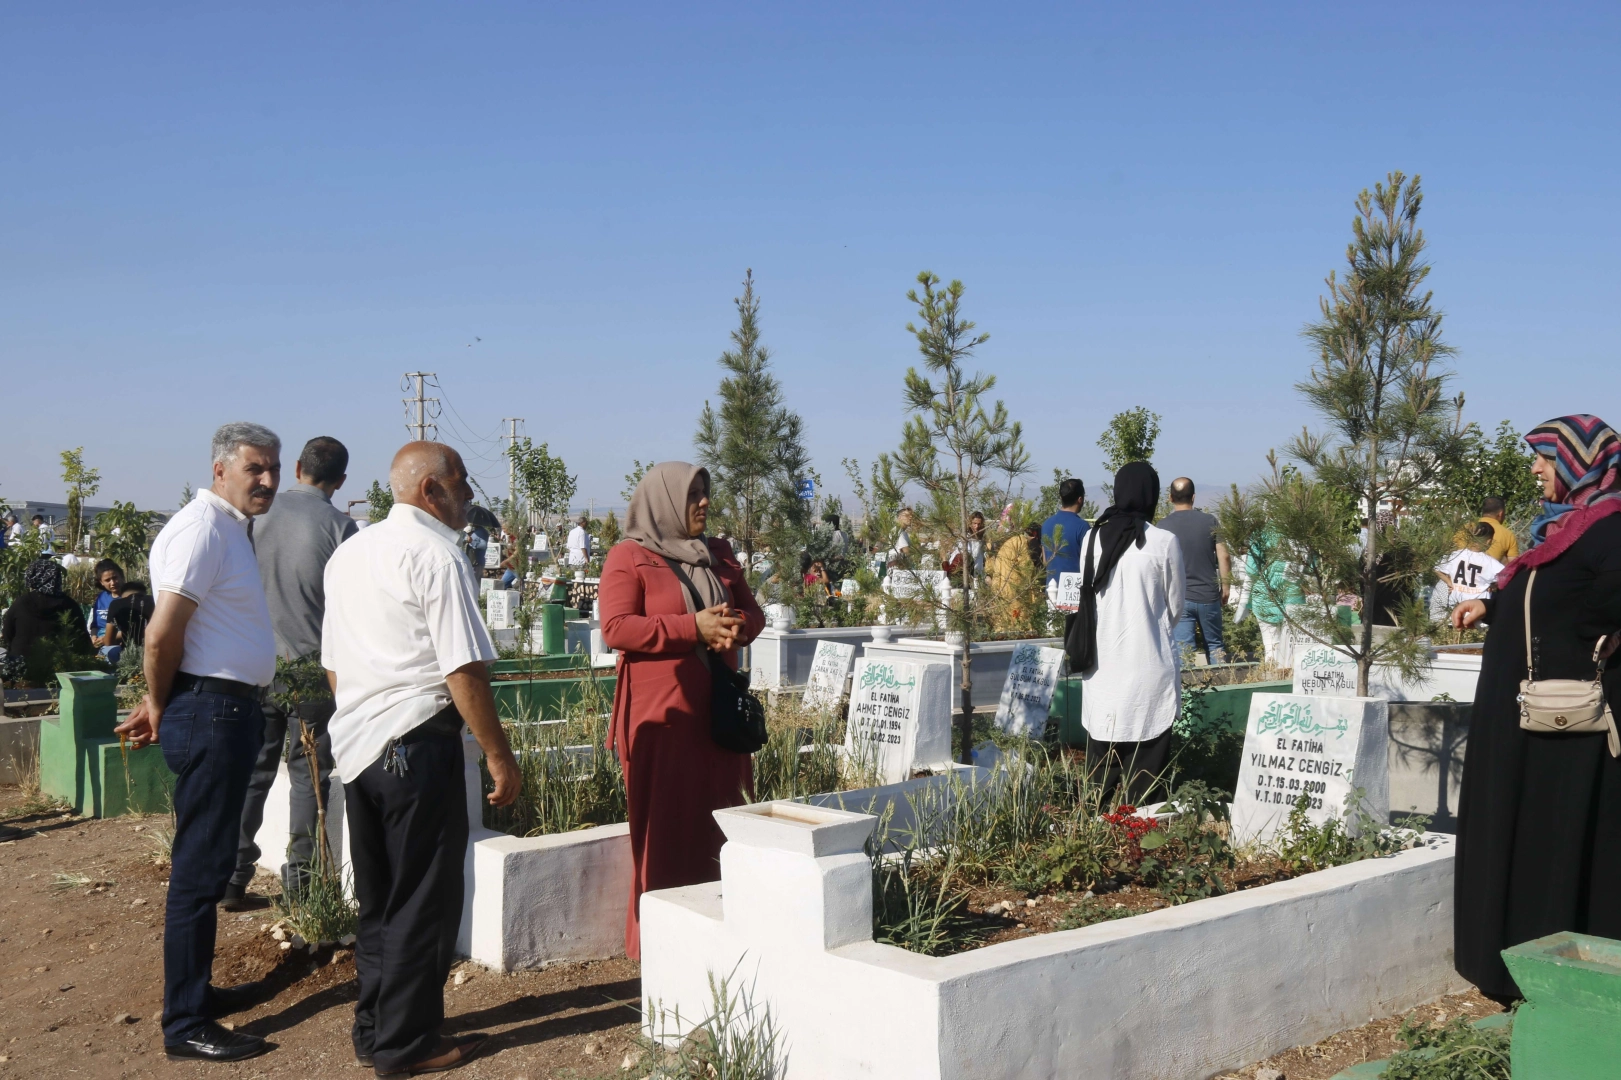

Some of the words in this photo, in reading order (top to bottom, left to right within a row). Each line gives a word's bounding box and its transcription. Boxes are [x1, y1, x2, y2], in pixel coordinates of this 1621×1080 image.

[1453, 560, 1483, 588] AT
[870, 691, 877, 702] EL
[880, 692, 900, 704] FATİHA
[856, 702, 882, 716] AHMET
[883, 706, 911, 720] CENGİZ
[1276, 737, 1287, 750] EL
[1291, 738, 1324, 754] FATİHA
[1251, 752, 1296, 771] YILMAZ
[1298, 758, 1343, 777] CENGİZ
